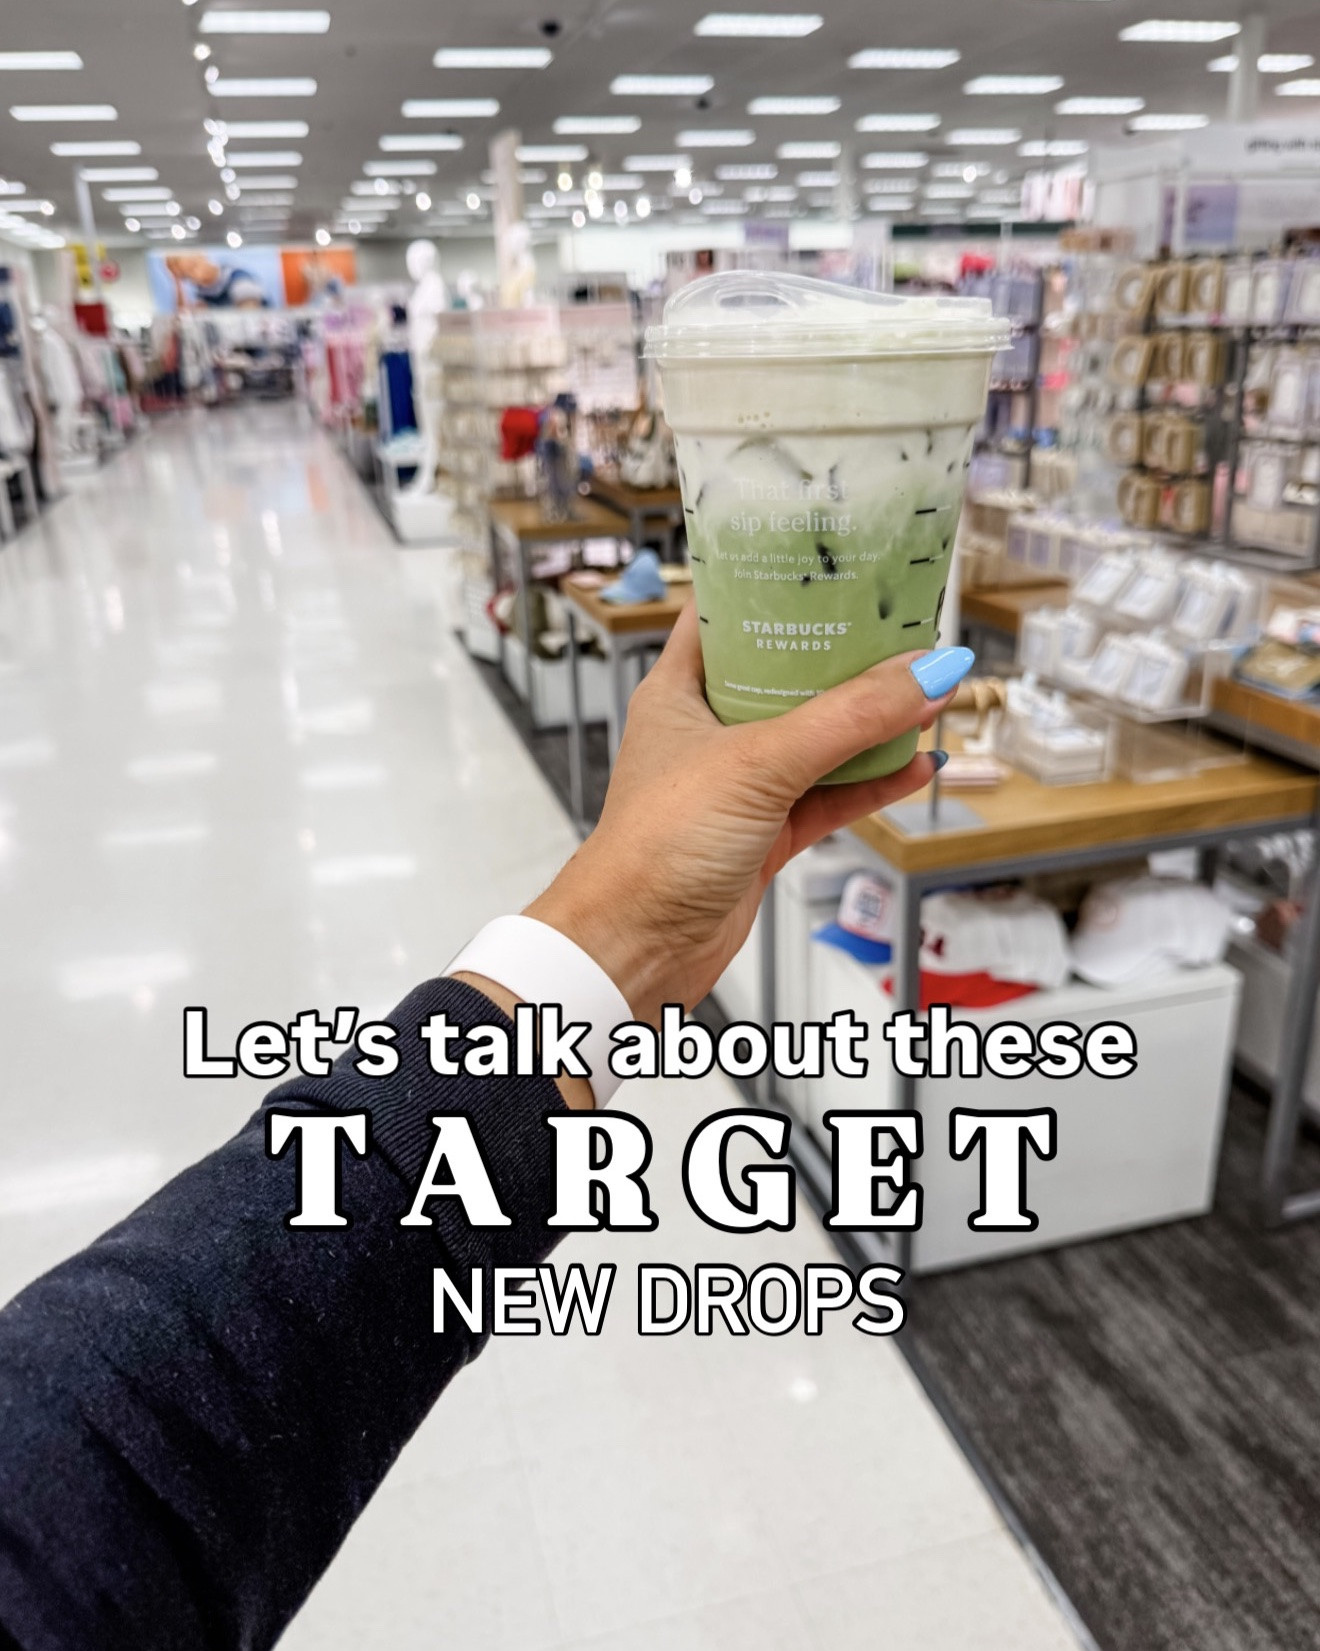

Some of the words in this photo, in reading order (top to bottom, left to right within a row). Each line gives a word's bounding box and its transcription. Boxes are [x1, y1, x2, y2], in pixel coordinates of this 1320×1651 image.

[734, 478, 790, 500] That
[799, 479, 850, 500] first
[730, 511, 762, 536] sip
[769, 510, 857, 536] feeling.
[729, 553, 739, 561] us
[741, 552, 758, 563] add
[761, 555, 768, 563] a
[770, 553, 795, 564] little
[797, 553, 815, 566] joy
[817, 554, 829, 564] to
[832, 554, 856, 566] your
[859, 551, 881, 563] day.
[734, 569, 752, 579] Join
[810, 570, 859, 581] Rewards.
[756, 638, 831, 651] REWARDS
